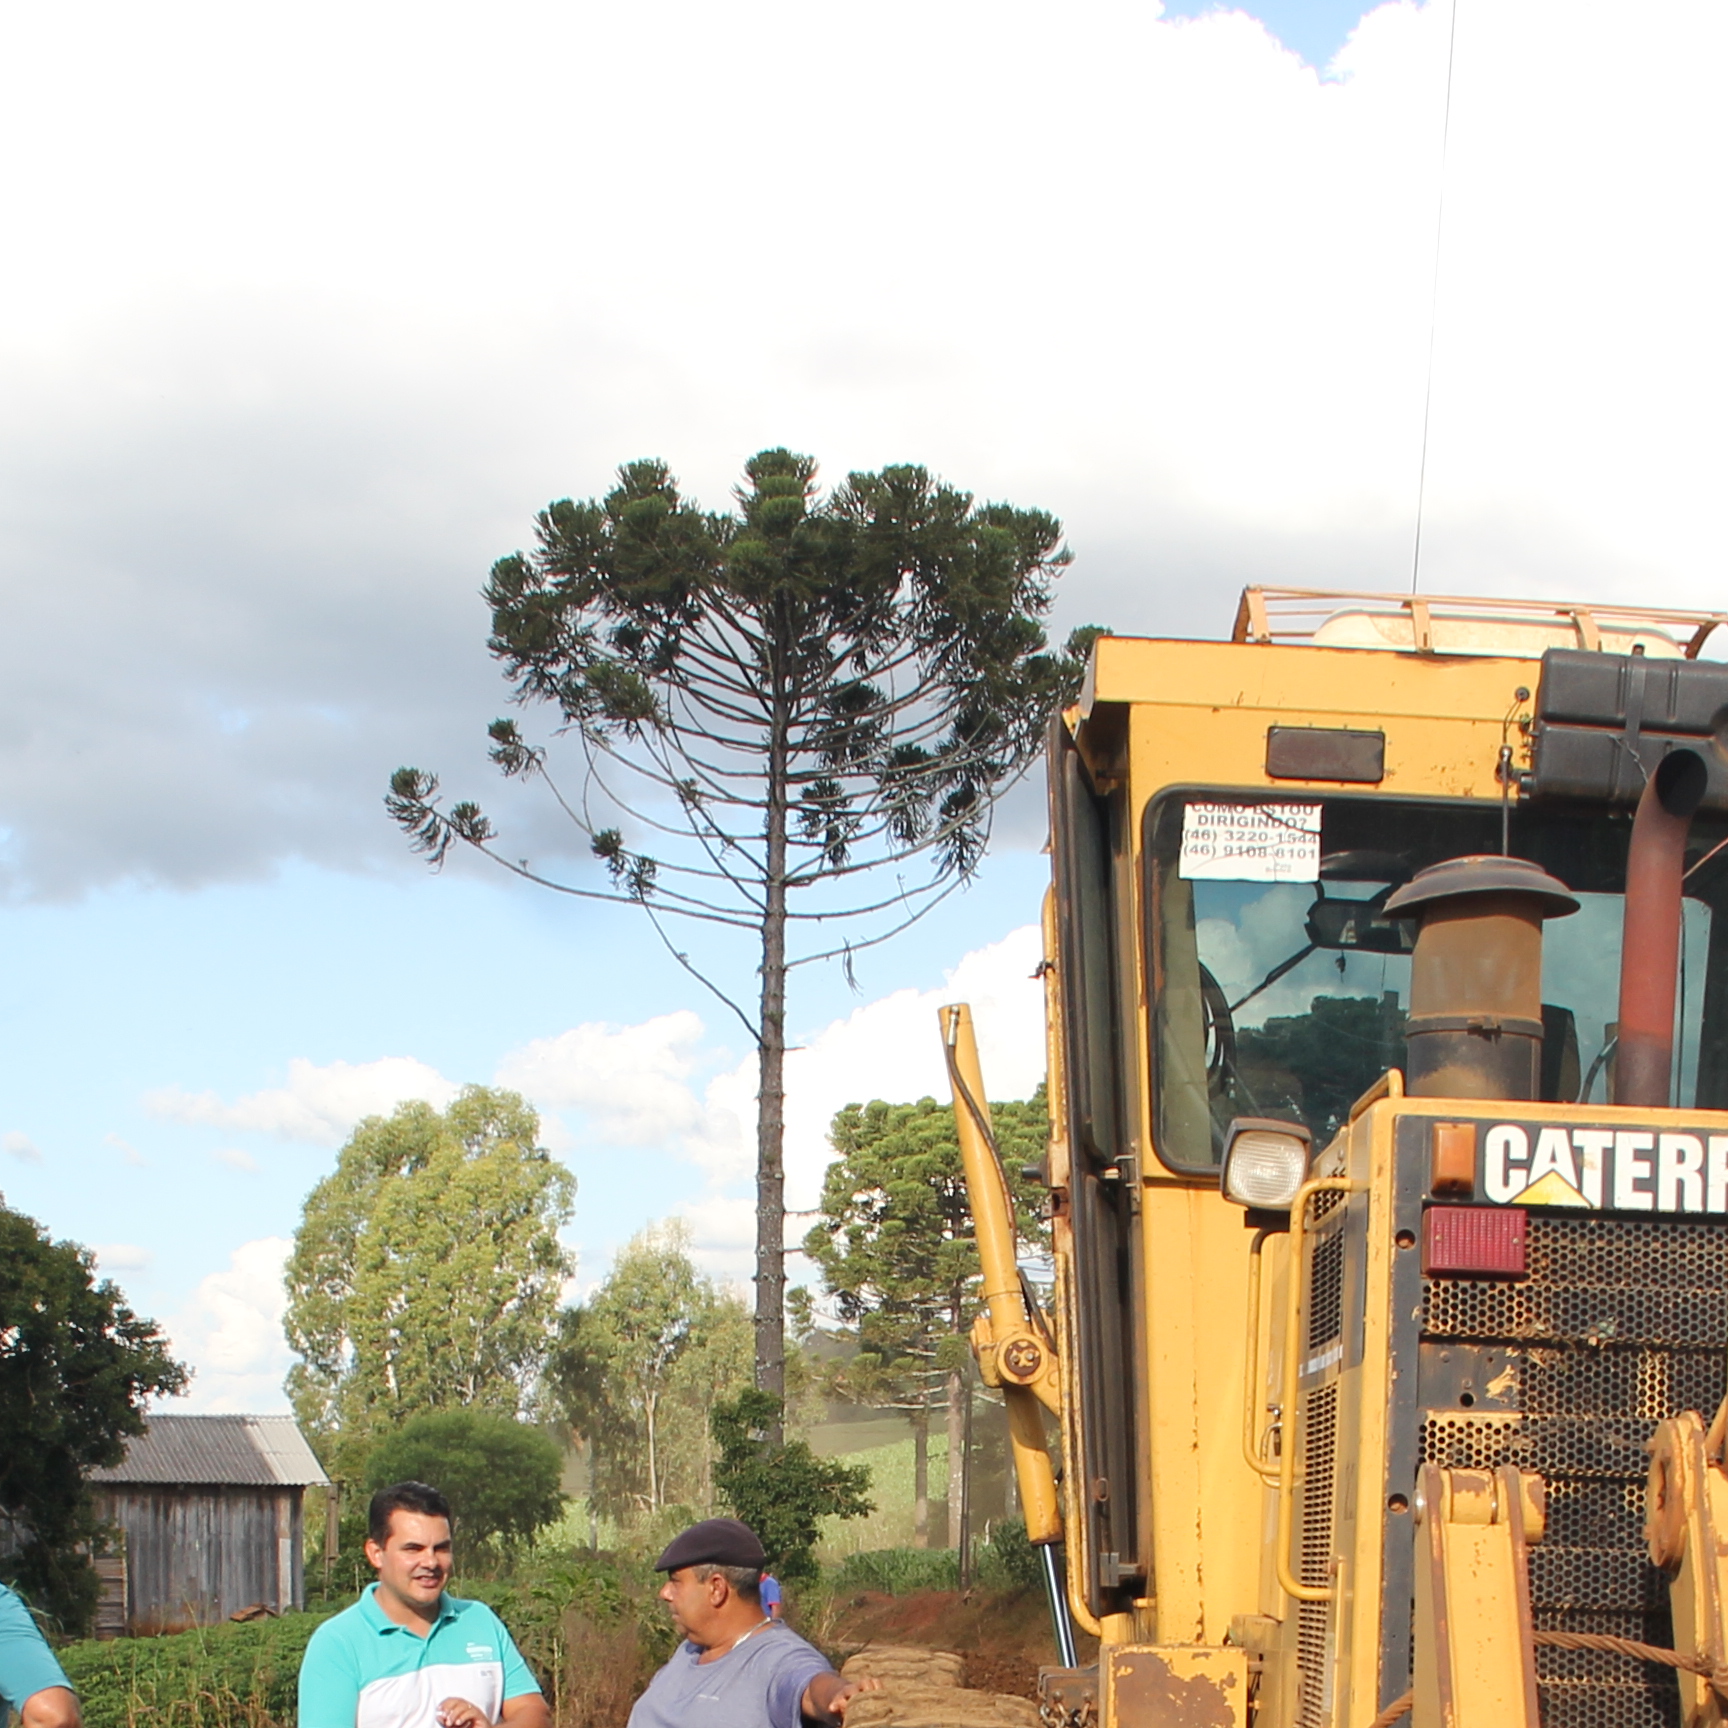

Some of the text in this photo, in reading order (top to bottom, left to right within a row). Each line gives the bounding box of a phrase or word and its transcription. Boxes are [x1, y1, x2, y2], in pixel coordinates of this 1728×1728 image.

[1198, 815, 1307, 829] DIRIGINDO?
[1184, 829, 1317, 844] (46) 3220-1544
[1184, 844, 1216, 857] (46)
